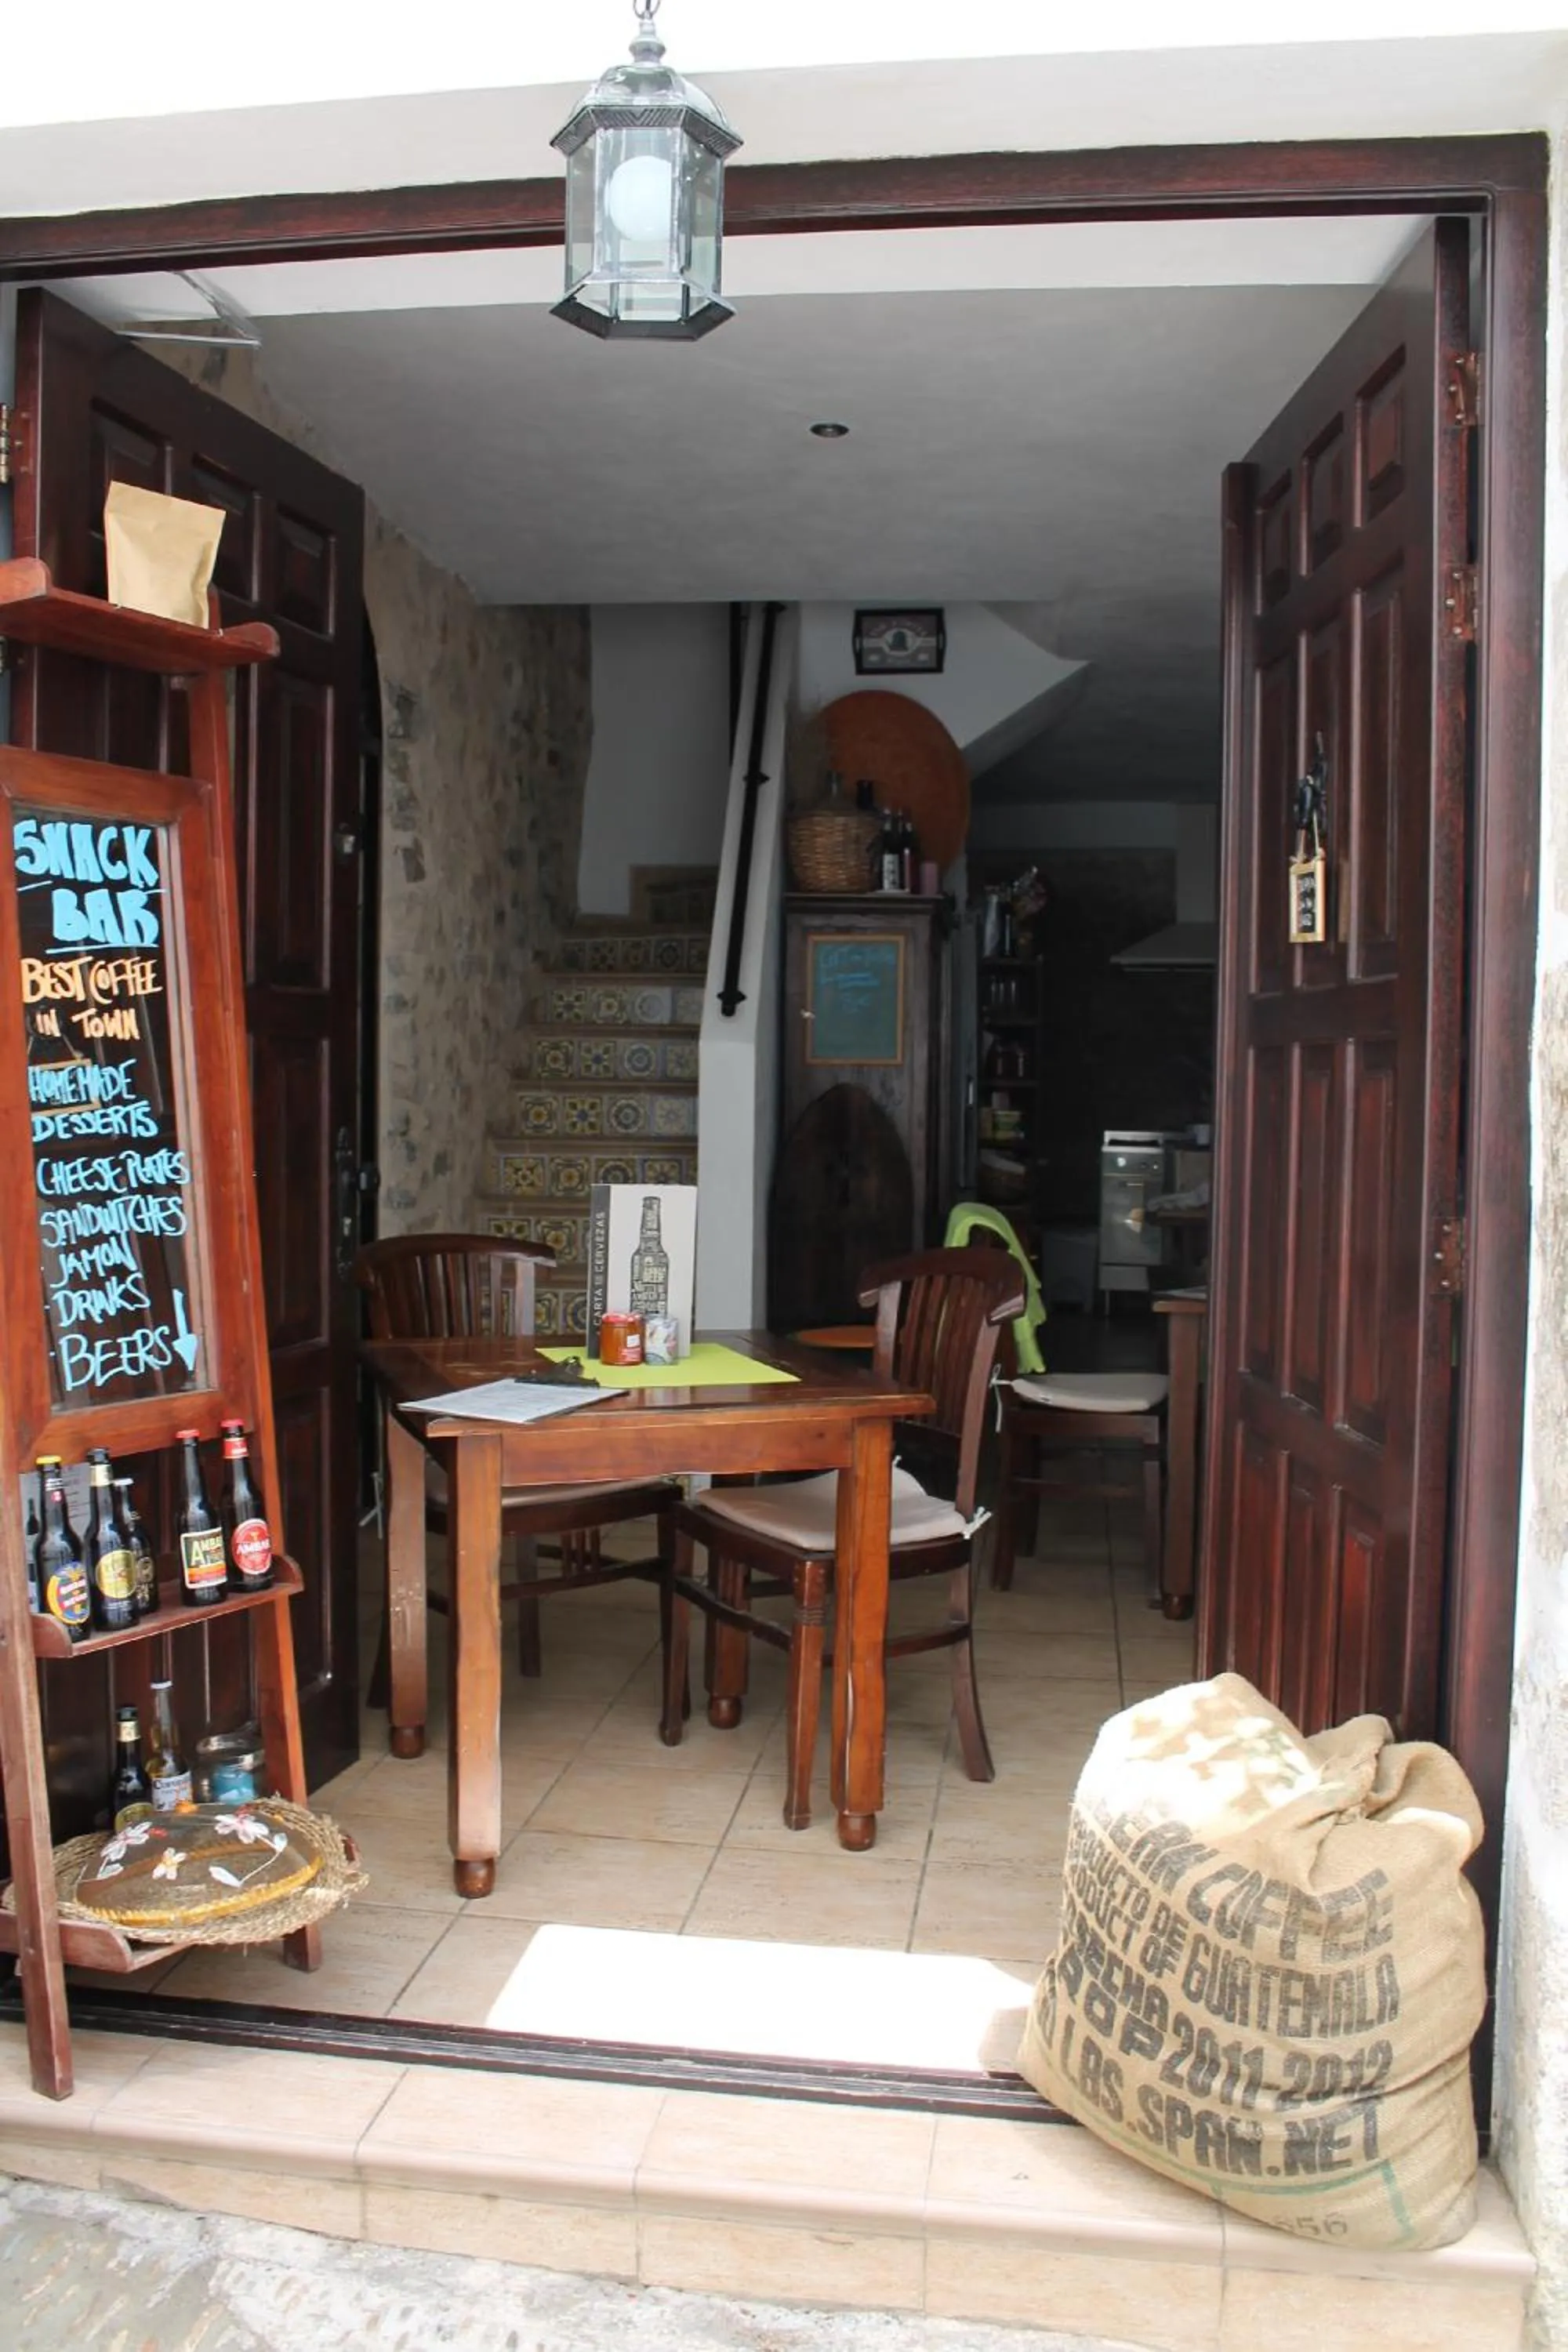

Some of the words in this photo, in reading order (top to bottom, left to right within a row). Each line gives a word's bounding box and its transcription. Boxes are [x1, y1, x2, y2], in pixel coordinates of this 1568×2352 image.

[13, 819, 158, 888] SNACK
[52, 889, 159, 945] BAR
[20, 956, 93, 1003] BEST
[89, 956, 163, 1004] COFFEE
[36, 1008, 61, 1036] IN
[71, 1007, 140, 1040] TOWN
[31, 1100, 158, 1142] DESSERTS
[37, 1156, 128, 1195] CHEESE
[118, 1149, 191, 1188] PLATES
[52, 1272, 151, 1327] DRINKS
[60, 1326, 172, 1391] BEERS
[1149, 1901, 1190, 1955] DE
[1186, 1863, 1394, 1962] COFFEE
[1140, 1934, 1183, 1979] OF
[1181, 1933, 1400, 2038] GUATEMALA
